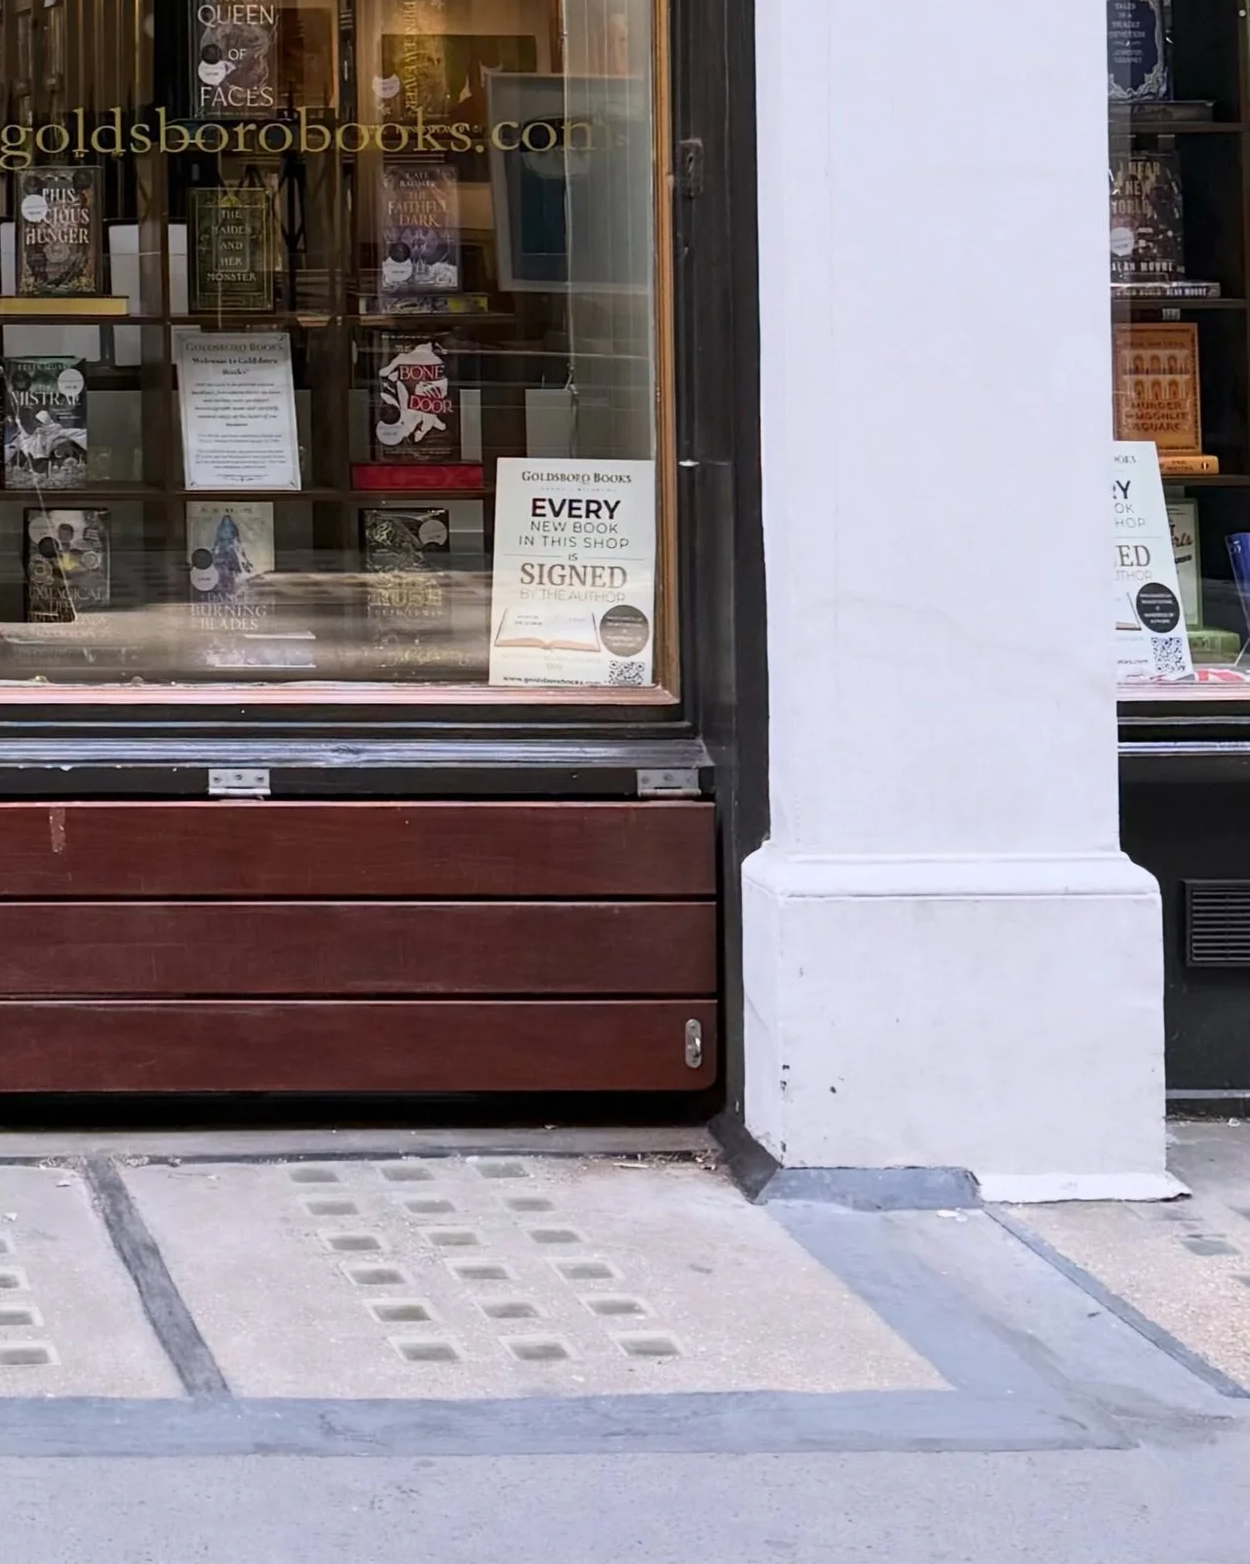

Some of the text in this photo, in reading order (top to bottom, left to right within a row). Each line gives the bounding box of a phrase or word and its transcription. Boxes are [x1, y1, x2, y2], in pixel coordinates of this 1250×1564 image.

[197, 3, 275, 28] QUEEN
[228, 48, 247, 61] OF
[403, 0, 419, 111] PRINEWEAVER
[200, 85, 274, 107] FACES
[399, 215, 442, 228] DARK
[25, 227, 90, 245] HUNGER
[399, 364, 446, 381] BONE
[409, 394, 454, 413] DOOR
[521, 470, 633, 485] GOLDSBORO BOOKS
[530, 497, 622, 521] EVERY
[530, 520, 619, 535] NEW BOOK
[518, 535, 630, 550] IN THIS SHOP
[568, 552, 579, 562] IS
[519, 562, 628, 589] SIGNED
[519, 587, 626, 604] BY THE AUTHOR
[190, 604, 267, 618] BURNING
[200, 618, 259, 631] BLADES
